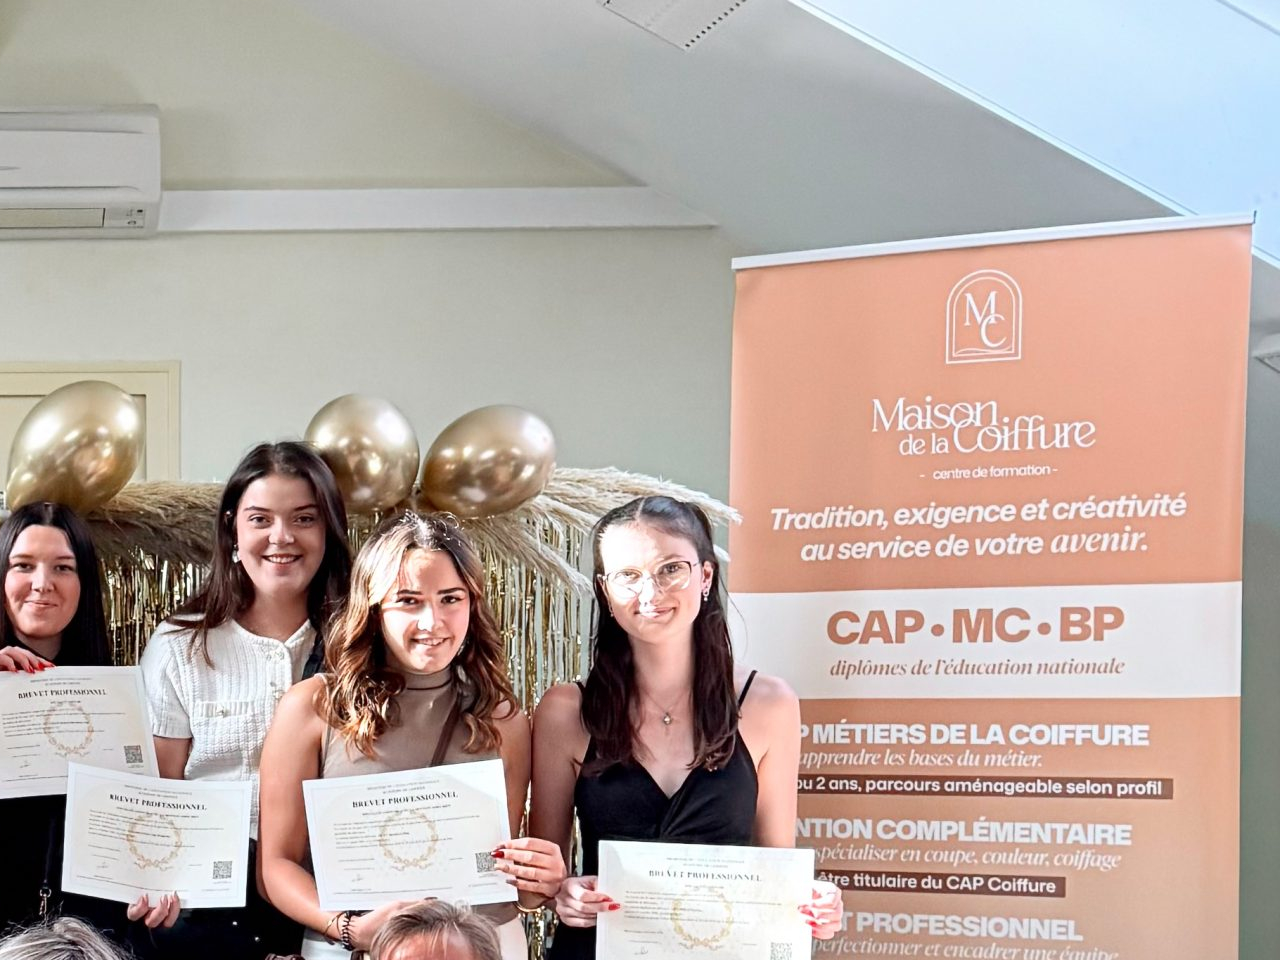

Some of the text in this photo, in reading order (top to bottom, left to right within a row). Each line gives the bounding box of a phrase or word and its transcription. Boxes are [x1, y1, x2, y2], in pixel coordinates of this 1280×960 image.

[872, 395, 998, 432] Maison
[899, 415, 1097, 455] de la Coiffure
[933, 464, 1051, 480] centre de formation
[771, 492, 1187, 530] Tradition, exigence et créativité
[801, 525, 1148, 561] au service de votre avenir.
[826, 606, 1125, 645] CAP MC BP
[830, 658, 1125, 679] diplômes de l'éducation nationale
[18, 688, 107, 700] BREVET PROFESSIONNEL
[813, 718, 926, 744] MÉTIERS
[930, 724, 966, 745] DE
[970, 724, 1006, 745] LA
[1009, 724, 1150, 746] COIFFURE
[800, 749, 1043, 768] apprendre les bases du métier.
[816, 776, 826, 790] 2
[829, 779, 862, 792] ans,
[866, 779, 940, 793] parcours
[944, 777, 1062, 795] aménageable
[1066, 780, 1113, 794] selon
[1117, 781, 1162, 796] profil
[109, 793, 208, 811] BREVET PROFESSIONNEL
[352, 791, 459, 808] BREVET PROFESSIONNEL
[796, 816, 1133, 845] NTION COMPLÉMENTAIRE
[901, 850, 920, 862] en
[924, 850, 978, 866] coupe,
[982, 848, 1050, 866] couleur,
[1053, 850, 1122, 871] coiffage
[648, 869, 762, 882] BREVET PROFESSIONNEL
[853, 873, 917, 888] titulaire
[921, 875, 942, 889] du
[946, 876, 984, 890] CAP
[988, 877, 1056, 893] Coiffure
[856, 911, 1084, 941] PROFESSIONNEL
[924, 944, 940, 957] et
[943, 942, 1021, 960] encadrer
